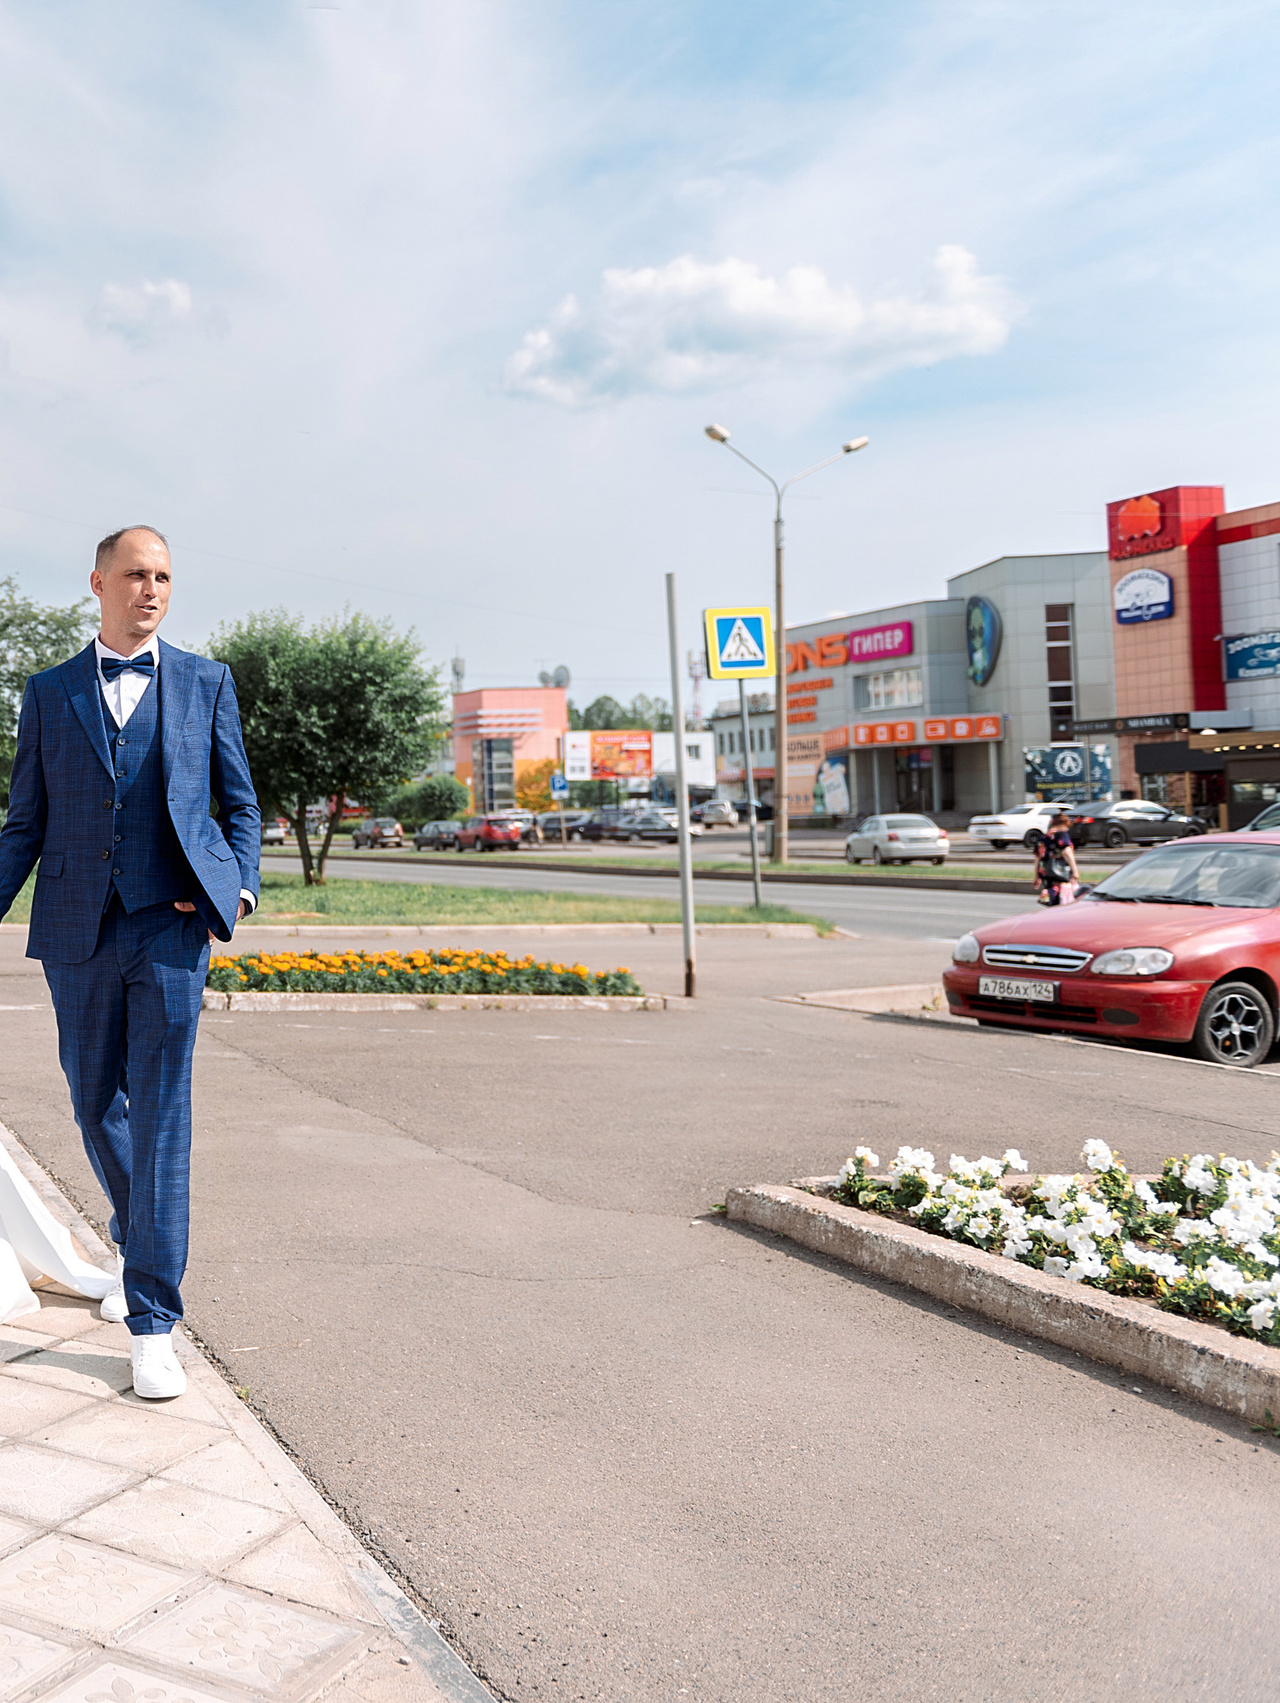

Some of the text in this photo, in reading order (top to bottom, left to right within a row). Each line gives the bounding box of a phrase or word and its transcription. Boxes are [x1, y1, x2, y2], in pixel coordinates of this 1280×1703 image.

[852, 628, 904, 656] ГИПЕР
[983, 980, 1051, 996] А786АХ 124
